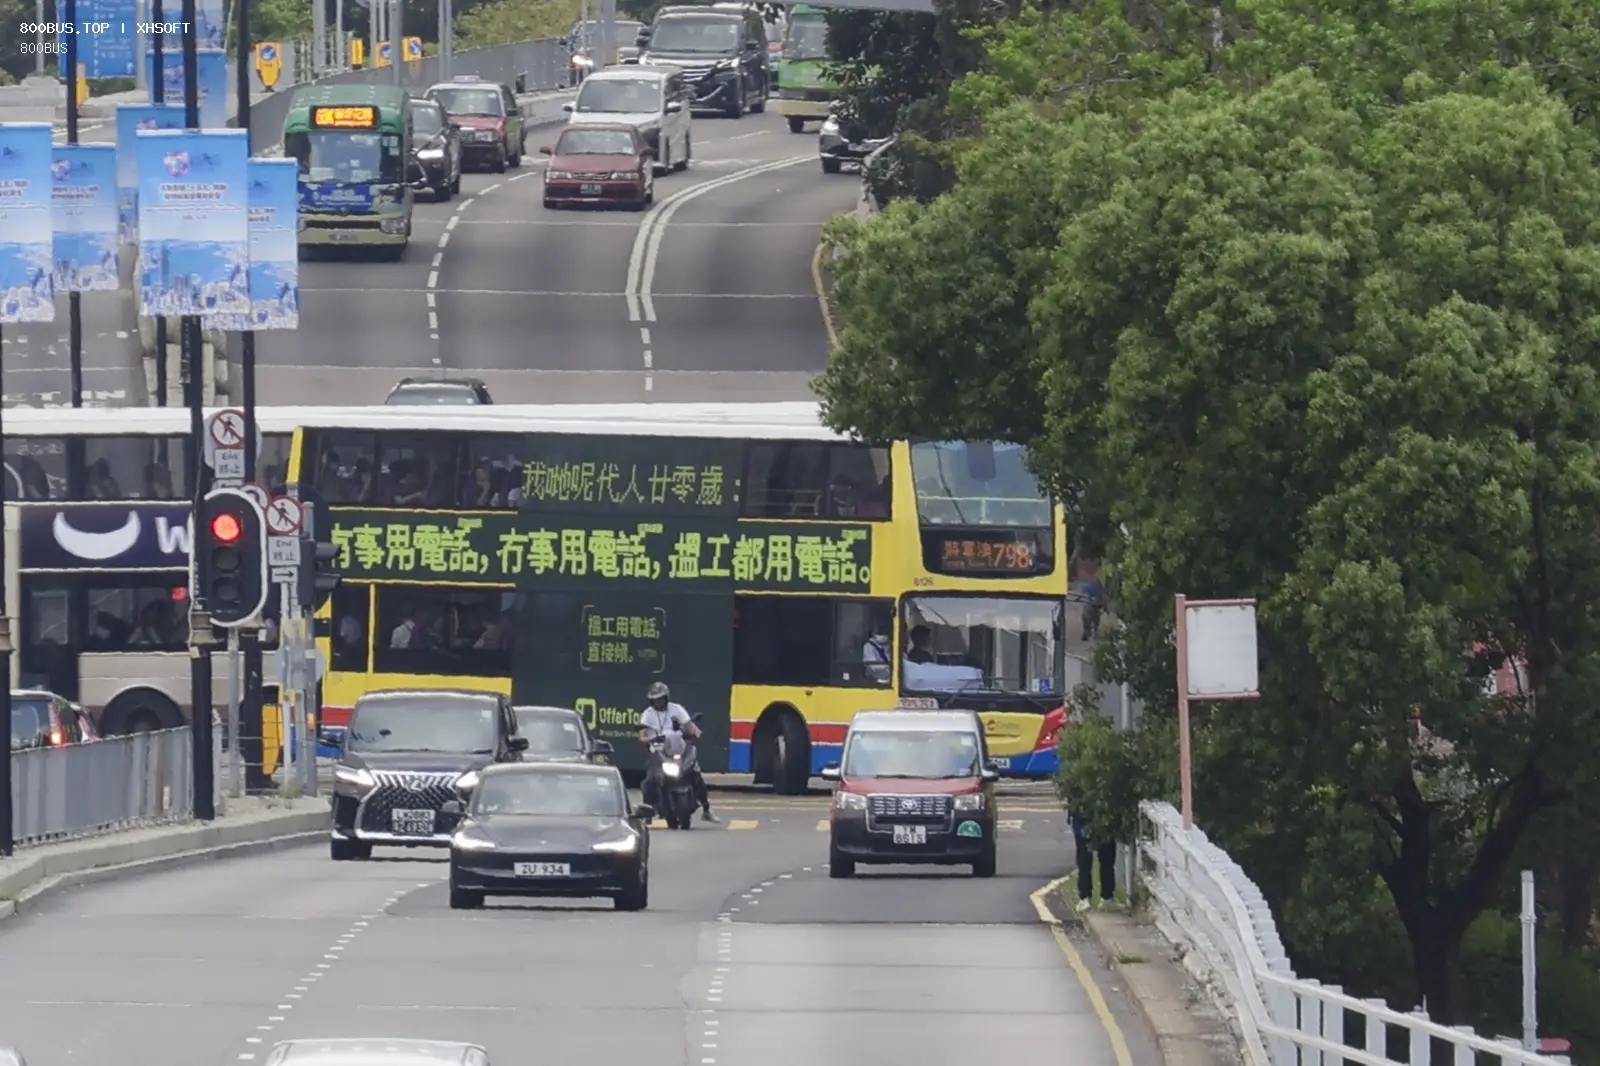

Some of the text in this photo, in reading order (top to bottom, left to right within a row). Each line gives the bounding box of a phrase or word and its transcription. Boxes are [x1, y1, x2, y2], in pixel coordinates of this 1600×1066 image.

[993, 542, 1029, 569] 798
[599, 706, 642, 725] OfferTo
[522, 864, 564, 874] ZU 934
